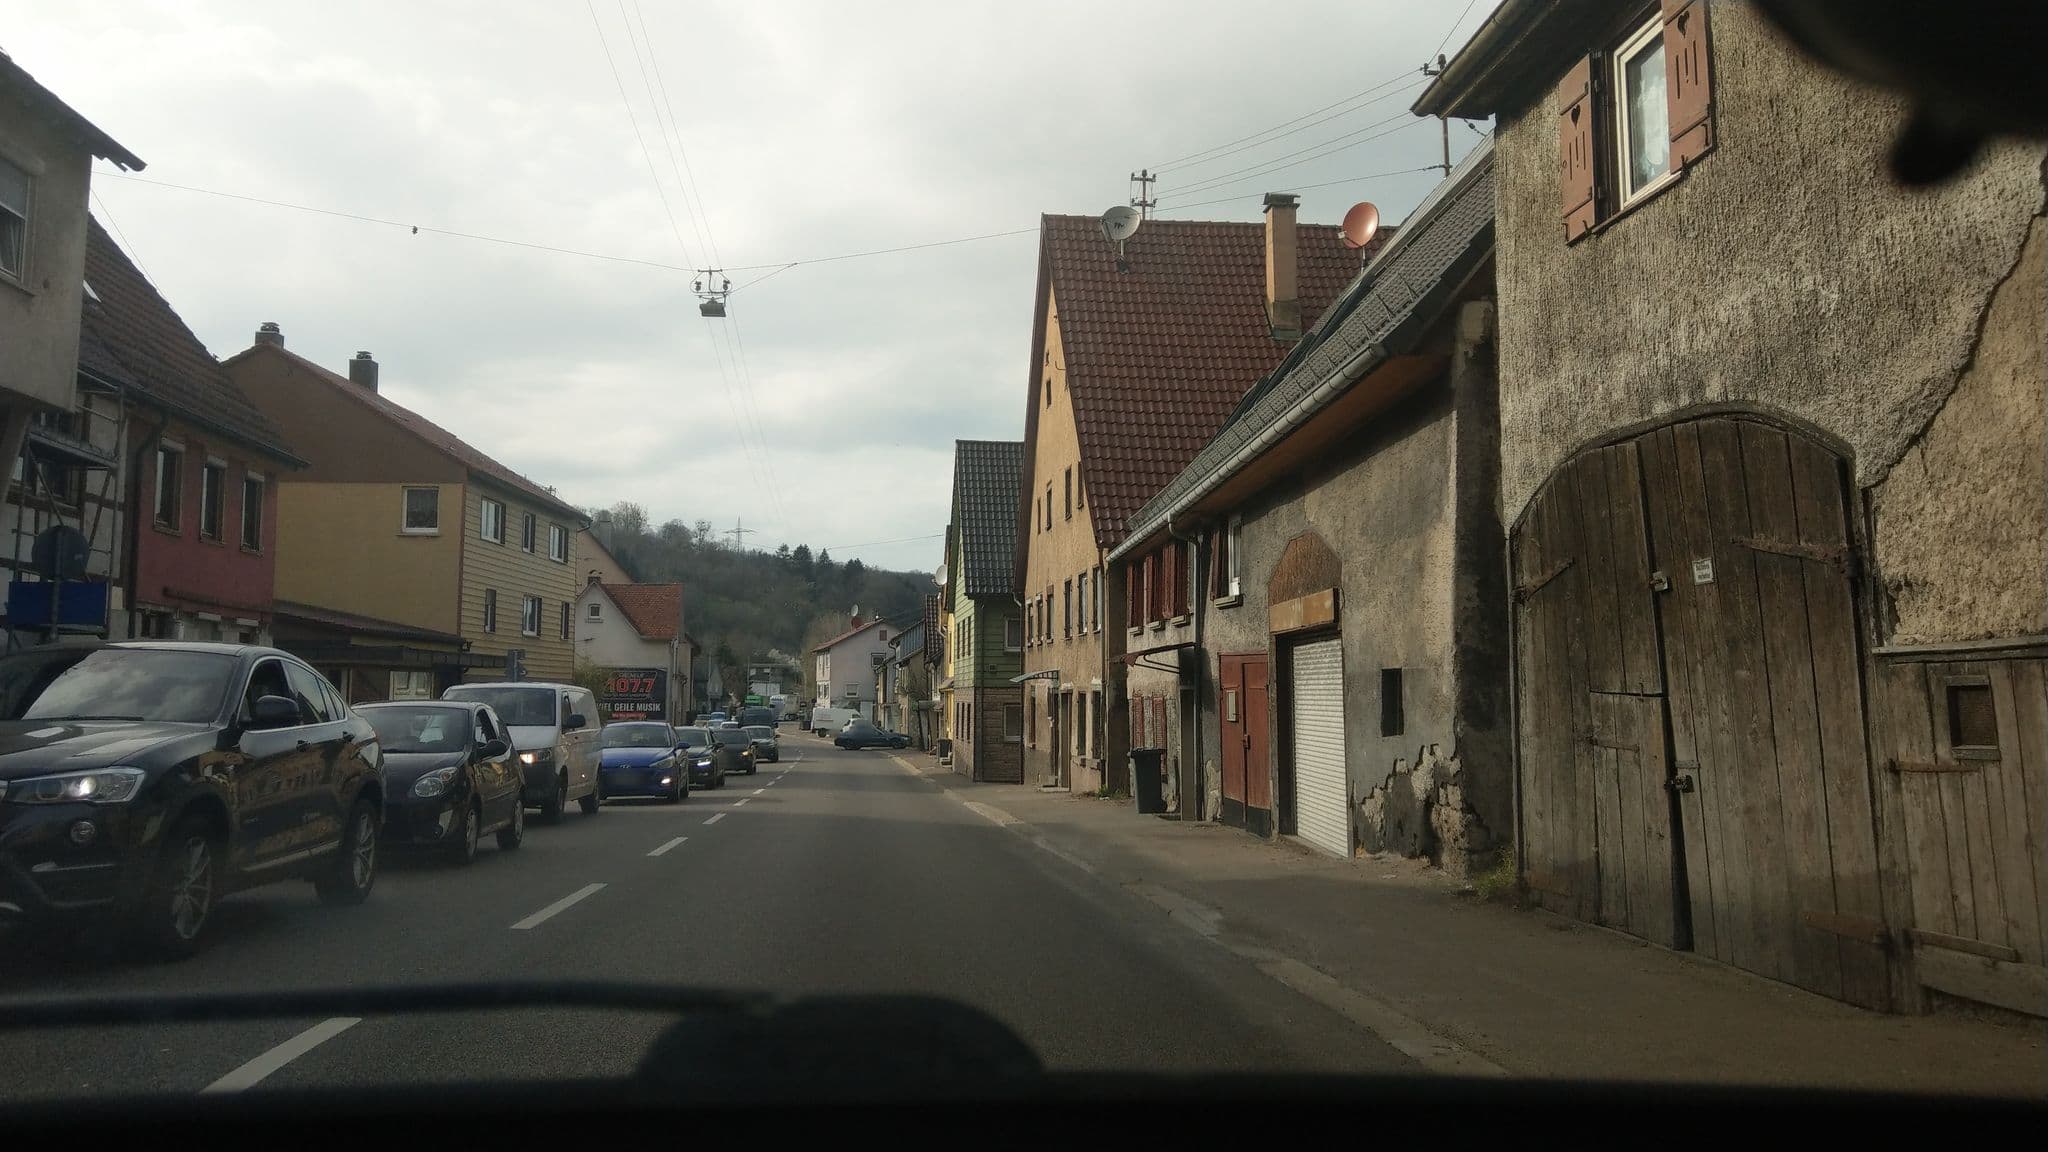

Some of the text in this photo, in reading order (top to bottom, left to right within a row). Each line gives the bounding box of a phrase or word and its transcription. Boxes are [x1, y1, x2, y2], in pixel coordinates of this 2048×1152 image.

[607, 677, 655, 693] 107.7
[614, 702, 635, 712] GEILE
[636, 702, 661, 712] MUSIK
